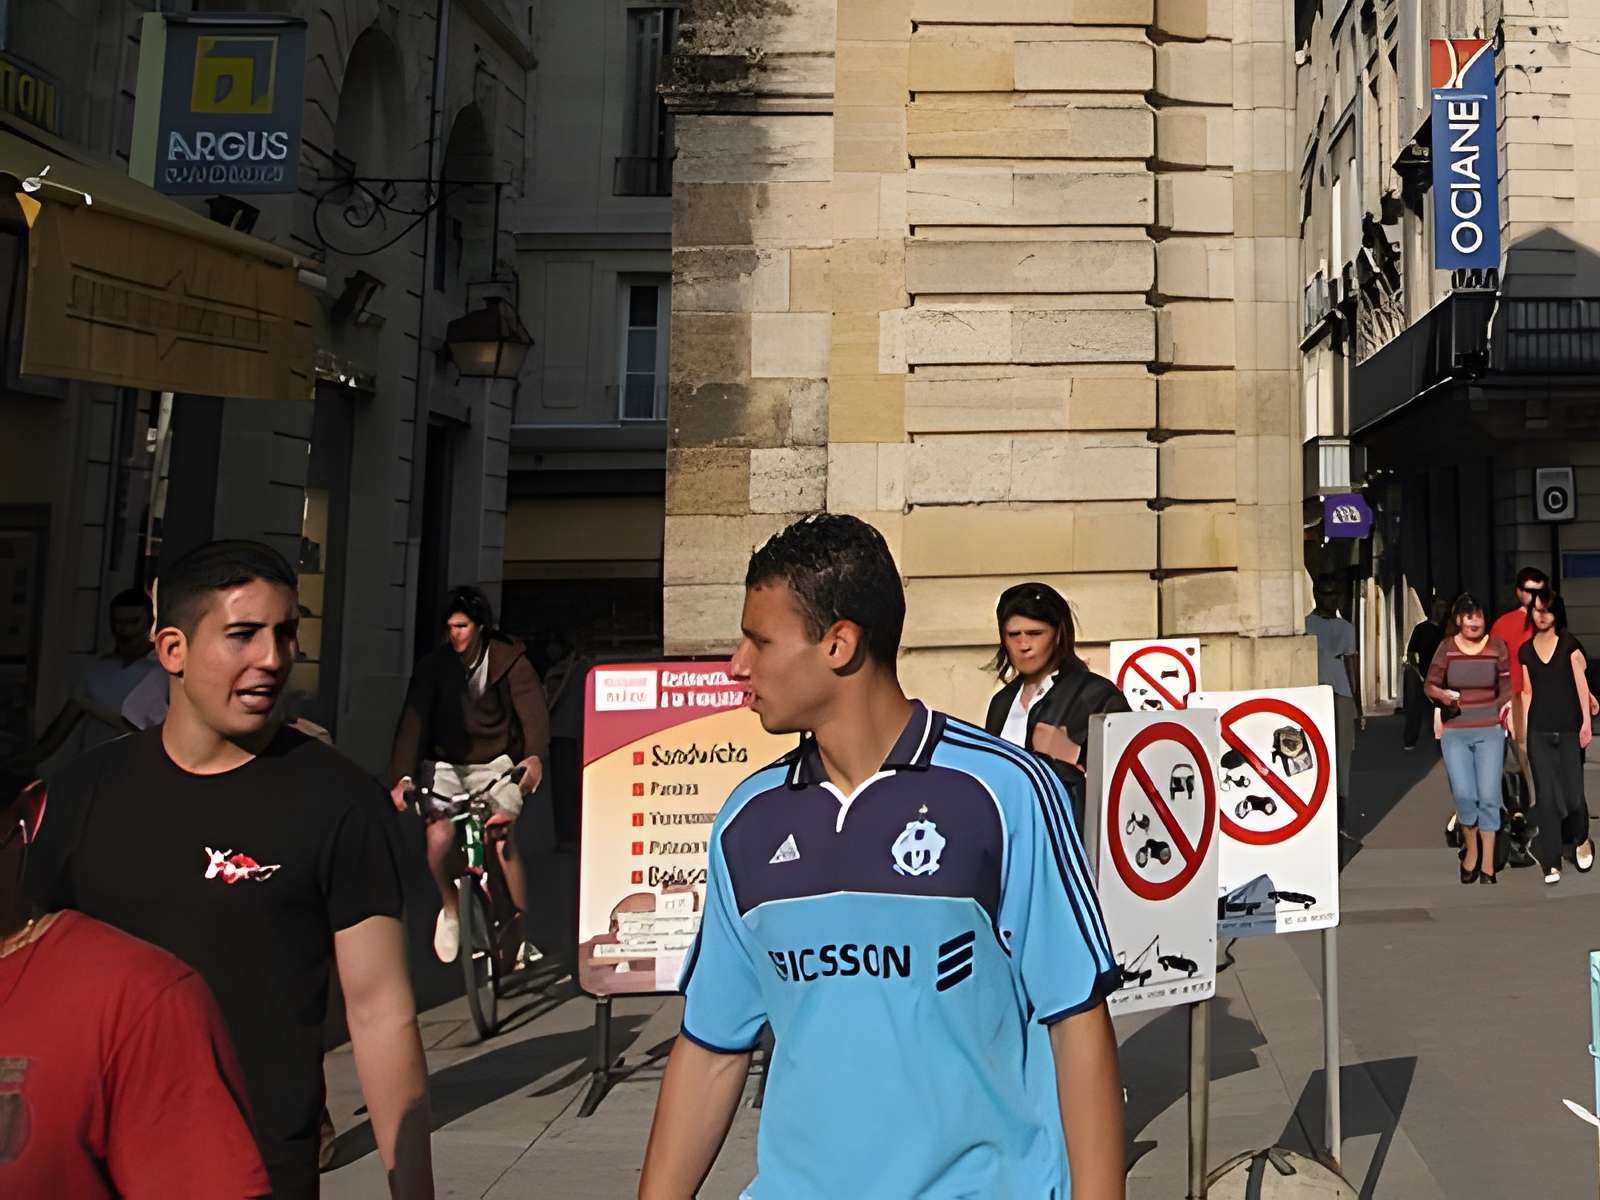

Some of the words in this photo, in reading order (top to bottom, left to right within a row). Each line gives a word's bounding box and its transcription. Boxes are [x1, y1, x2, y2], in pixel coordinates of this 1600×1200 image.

[167, 131, 289, 161] ARGUS
[1448, 101, 1484, 254] OCIANE
[768, 943, 912, 982] ICSSON
